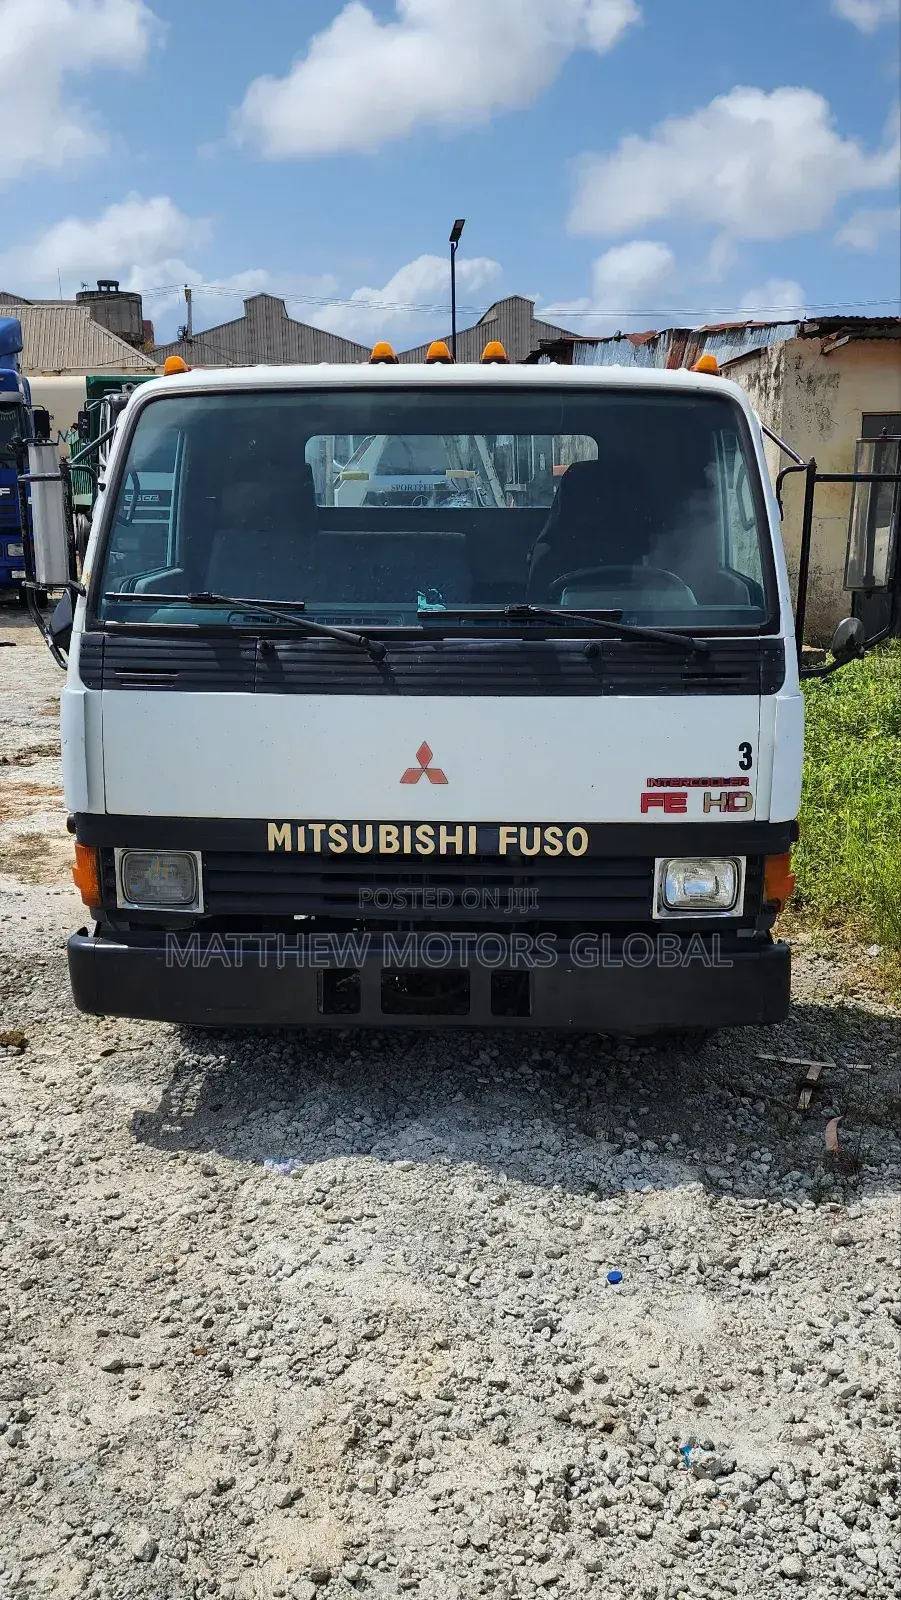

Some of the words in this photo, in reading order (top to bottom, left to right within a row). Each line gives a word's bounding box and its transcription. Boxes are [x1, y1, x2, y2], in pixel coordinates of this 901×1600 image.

[738, 741, 753, 771] 3
[646, 777, 750, 788] INTERCOOLER
[640, 792, 688, 814] FE
[703, 791, 754, 814] HD
[267, 822, 477, 855] MITSUBISHI
[499, 825, 589, 857] FUSO
